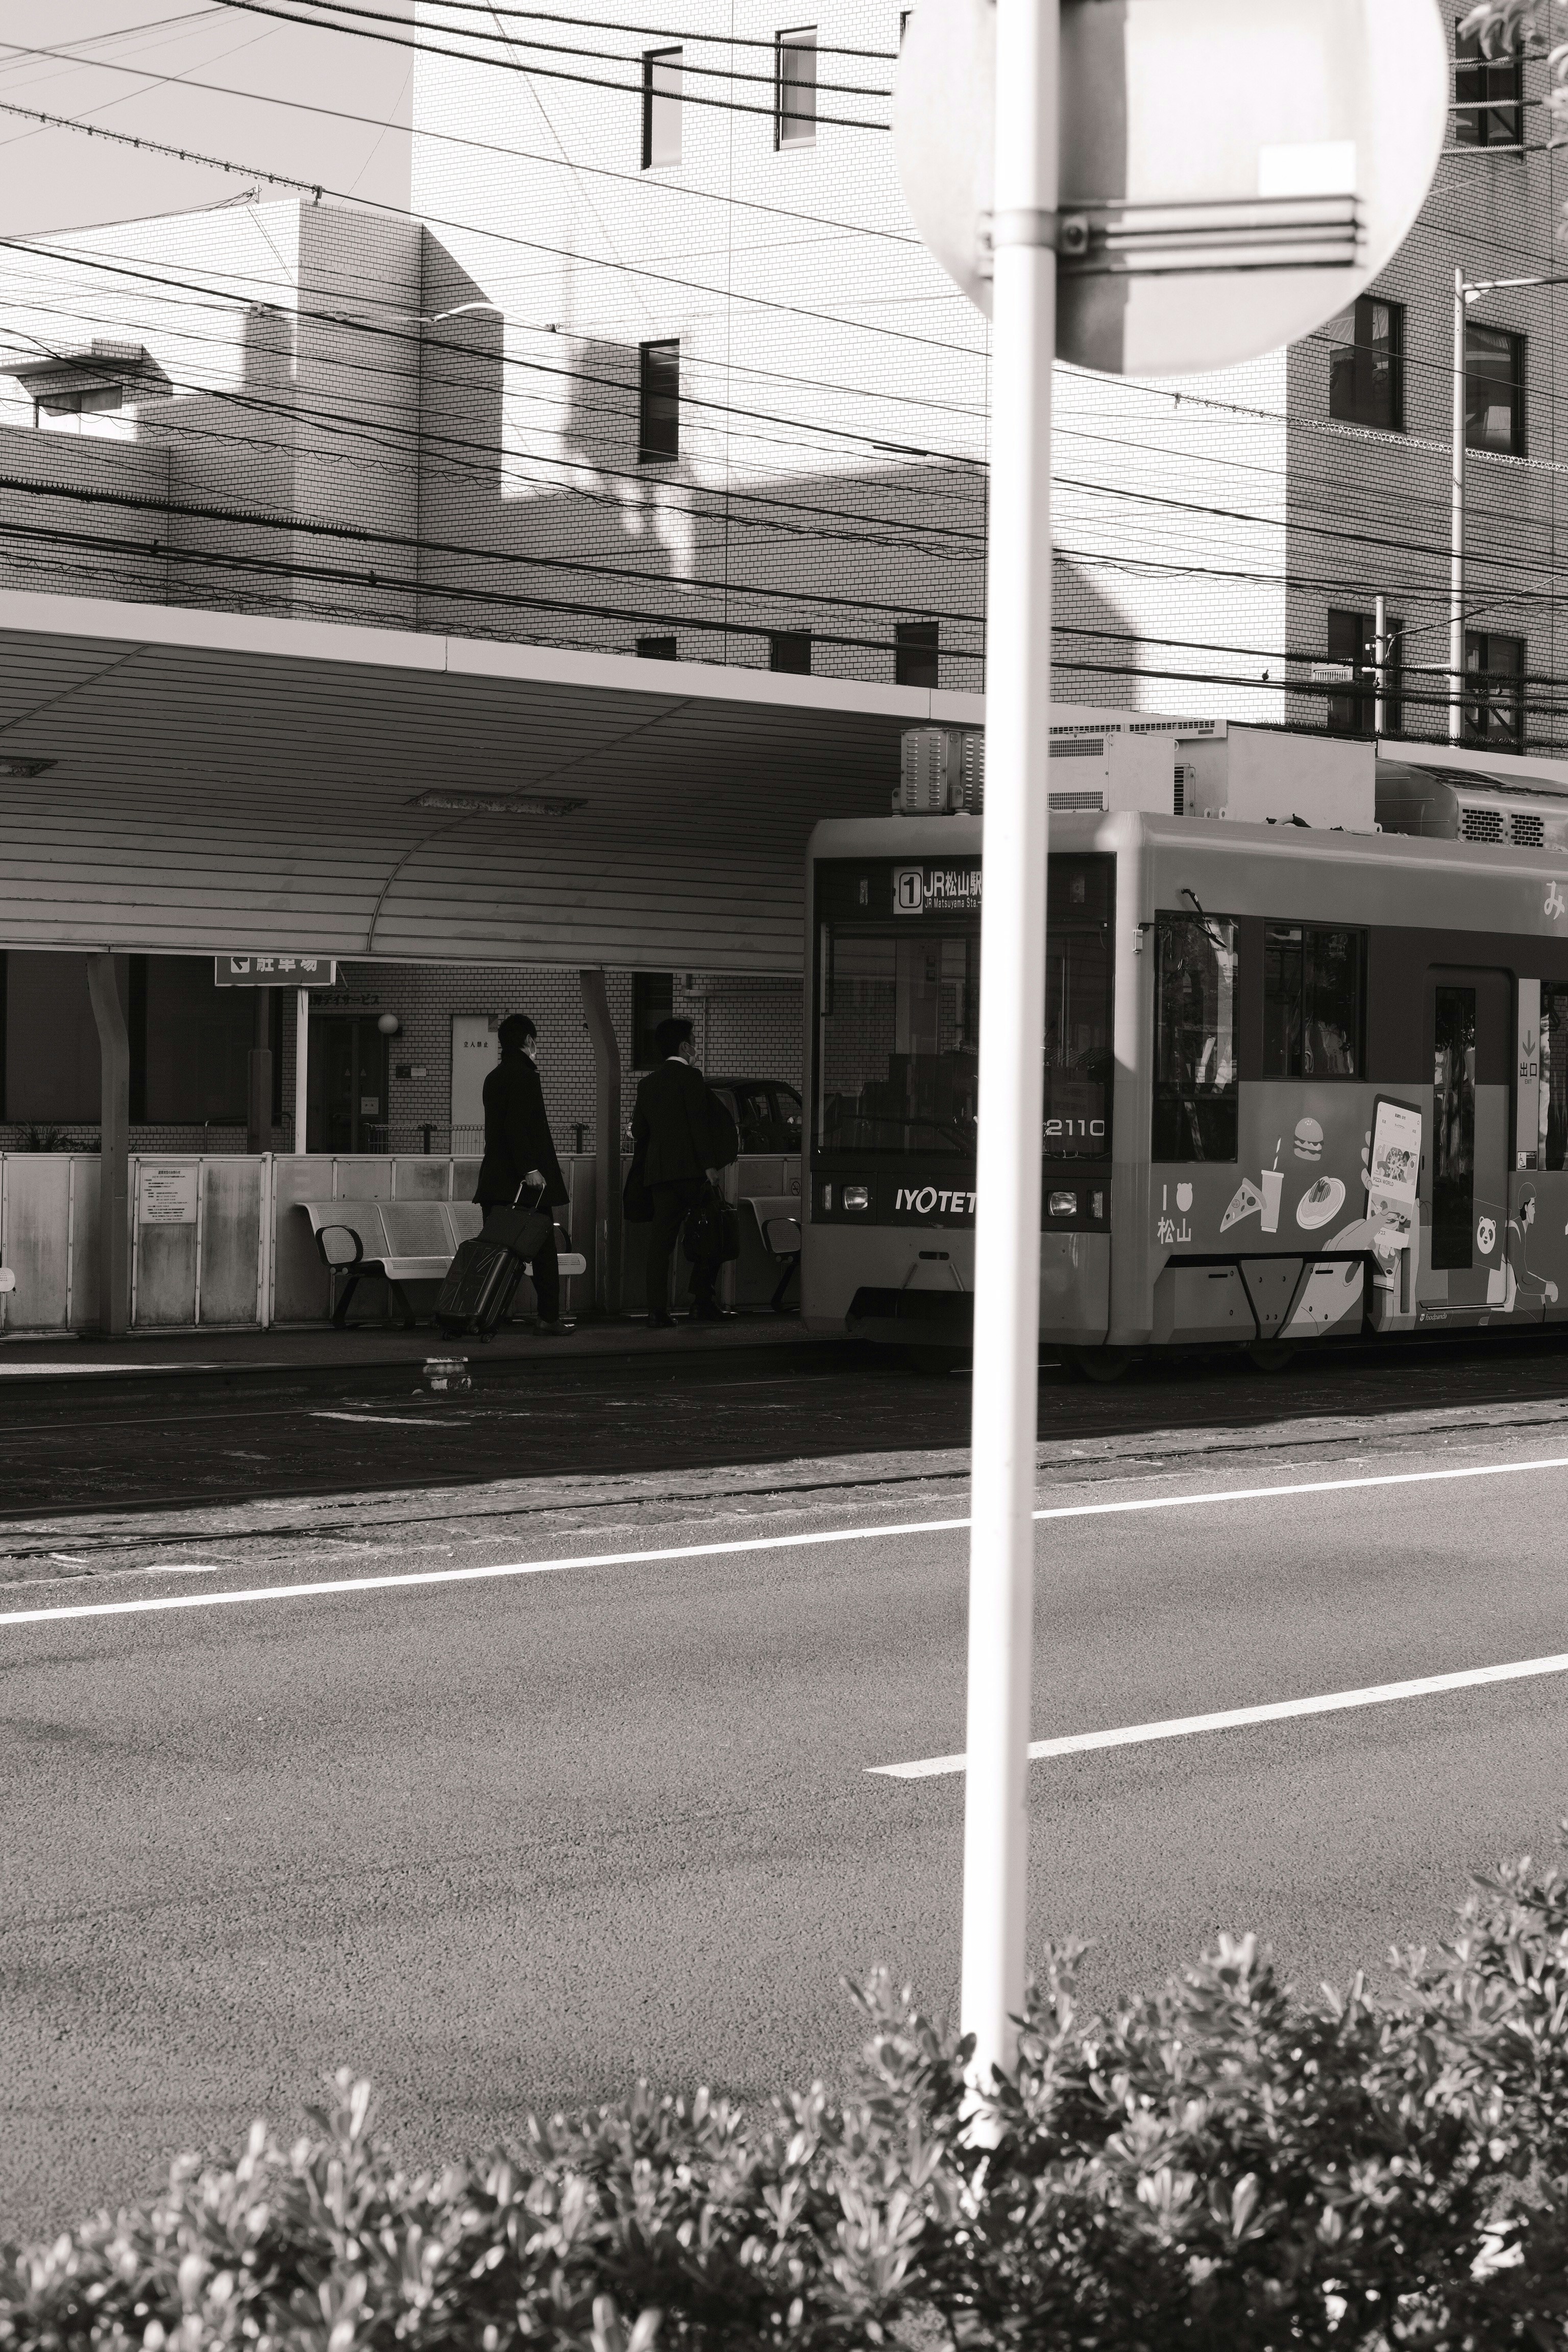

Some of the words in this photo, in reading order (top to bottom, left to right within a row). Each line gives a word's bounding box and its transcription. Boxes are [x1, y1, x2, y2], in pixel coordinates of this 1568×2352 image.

[903, 876, 914, 904] 1
[923, 871, 983, 897] JR松山駅
[925, 898, 932, 909] JR
[934, 898, 965, 910] Matsuyama
[1544, 880, 1565, 920] み
[1520, 1062, 1537, 1077] 出口
[1046, 1119, 1105, 1136] 2110
[1382, 1179, 1394, 1187] WORLD
[895, 1187, 977, 1214] IYOTET
[1157, 1216, 1191, 1244] 松山
[1425, 1312, 1448, 1321] foodpanda
